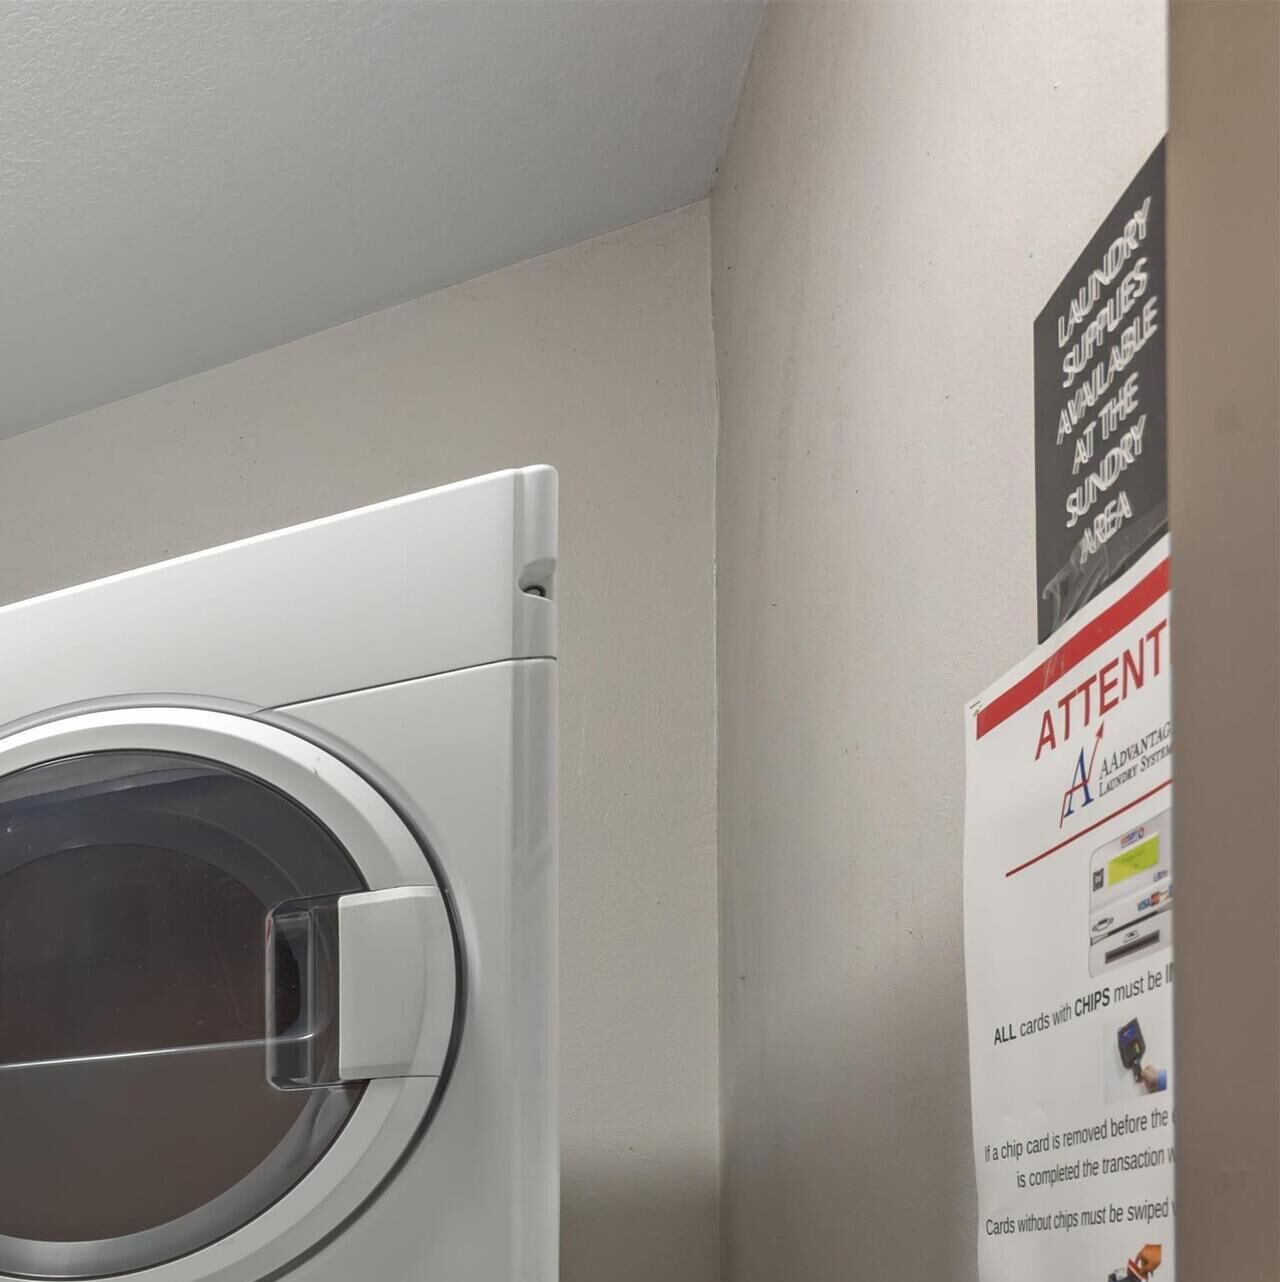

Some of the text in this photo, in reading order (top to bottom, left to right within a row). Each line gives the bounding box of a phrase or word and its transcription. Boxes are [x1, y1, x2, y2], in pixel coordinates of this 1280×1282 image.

[1058, 195, 1151, 347] LAUNDRY
[1062, 256, 1147, 388] SUPPLIES
[1056, 296, 1158, 445] AVAILABLE
[1072, 371, 1139, 475] AT THE
[1066, 414, 1146, 528] SUNDRY
[1080, 491, 1133, 564] AREA
[1035, 618, 1167, 761] ATTENT
[1098, 721, 1171, 781] AADVANTAG
[1098, 765, 1137, 798] LAUNDRY
[994, 1024, 1017, 1045] ALL
[1020, 1013, 1050, 1036] cards
[1052, 1003, 1072, 1026] with
[1075, 988, 1110, 1017] CHIPS
[1113, 977, 1144, 1003] must
[1148, 970, 1162, 991] be
